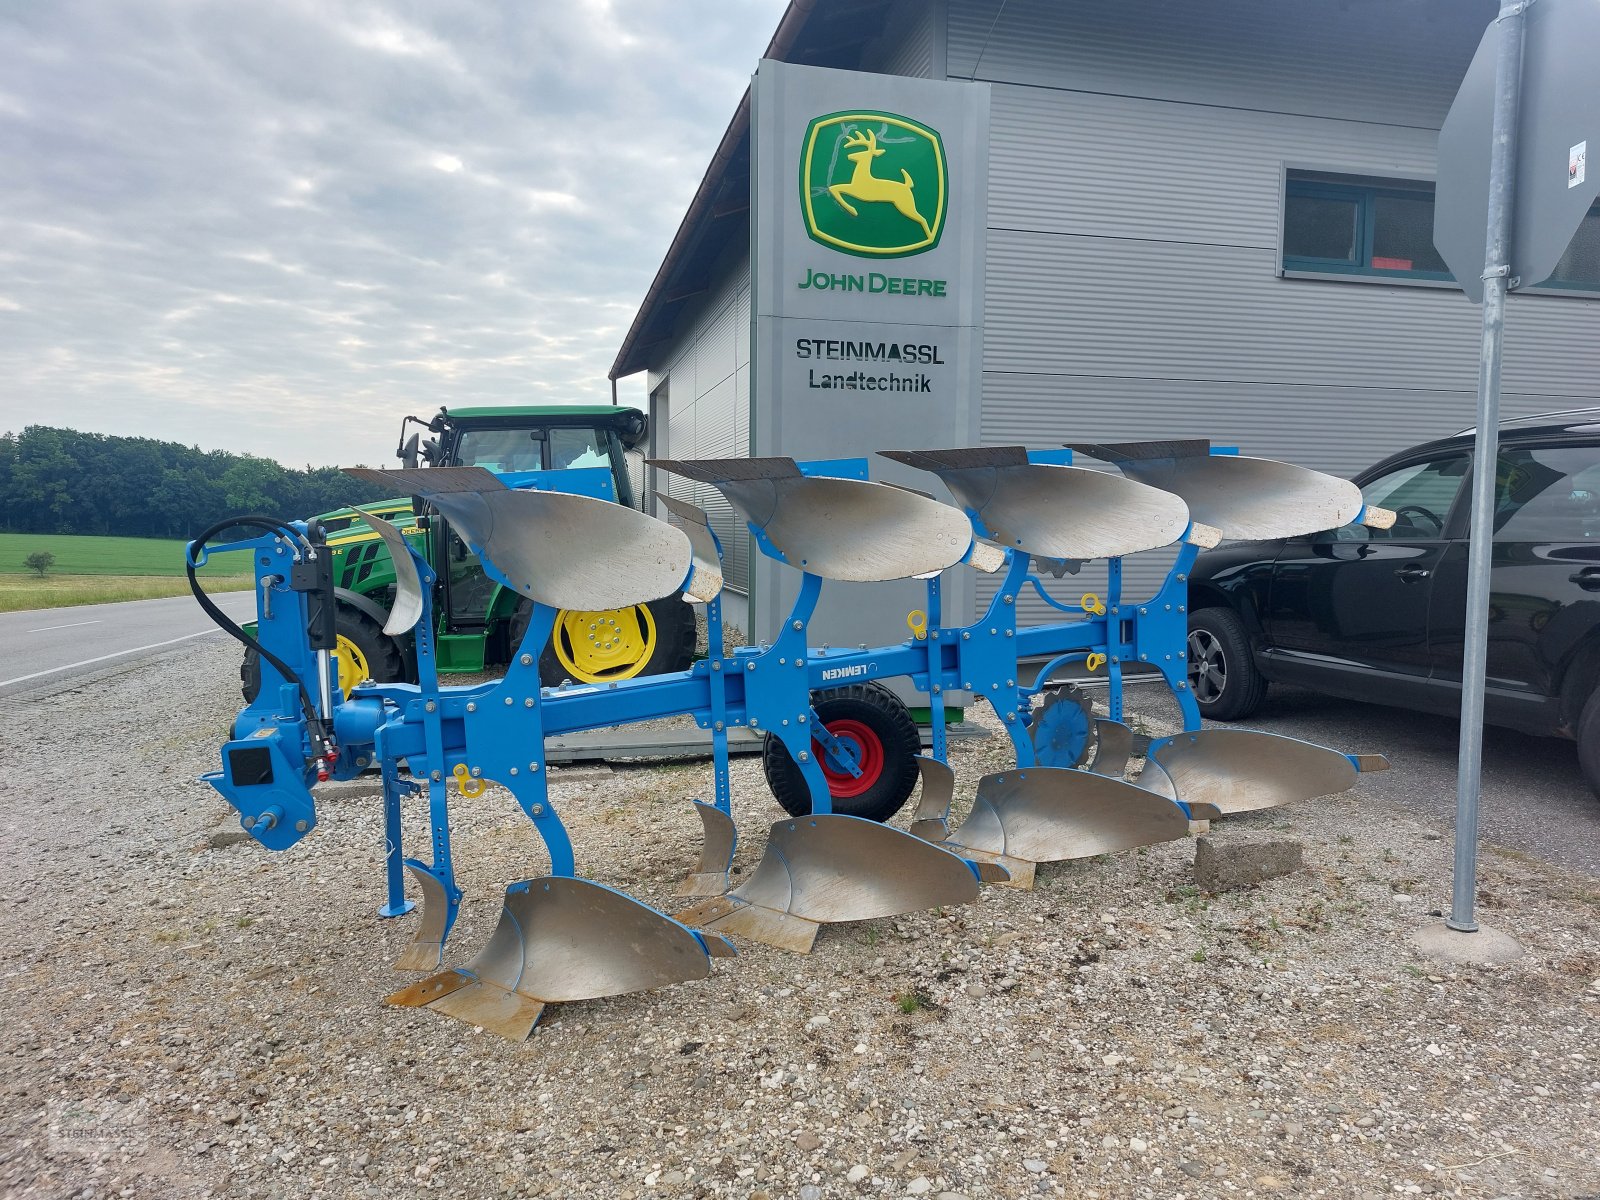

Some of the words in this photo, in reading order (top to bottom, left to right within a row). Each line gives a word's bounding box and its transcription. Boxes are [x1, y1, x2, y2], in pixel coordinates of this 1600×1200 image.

[798, 269, 864, 292] JOHN
[868, 272, 947, 298] DEERE
[796, 338, 945, 365] STEINMASSL
[809, 369, 932, 393] Landtechnik
[822, 664, 867, 681] LEMKEN
